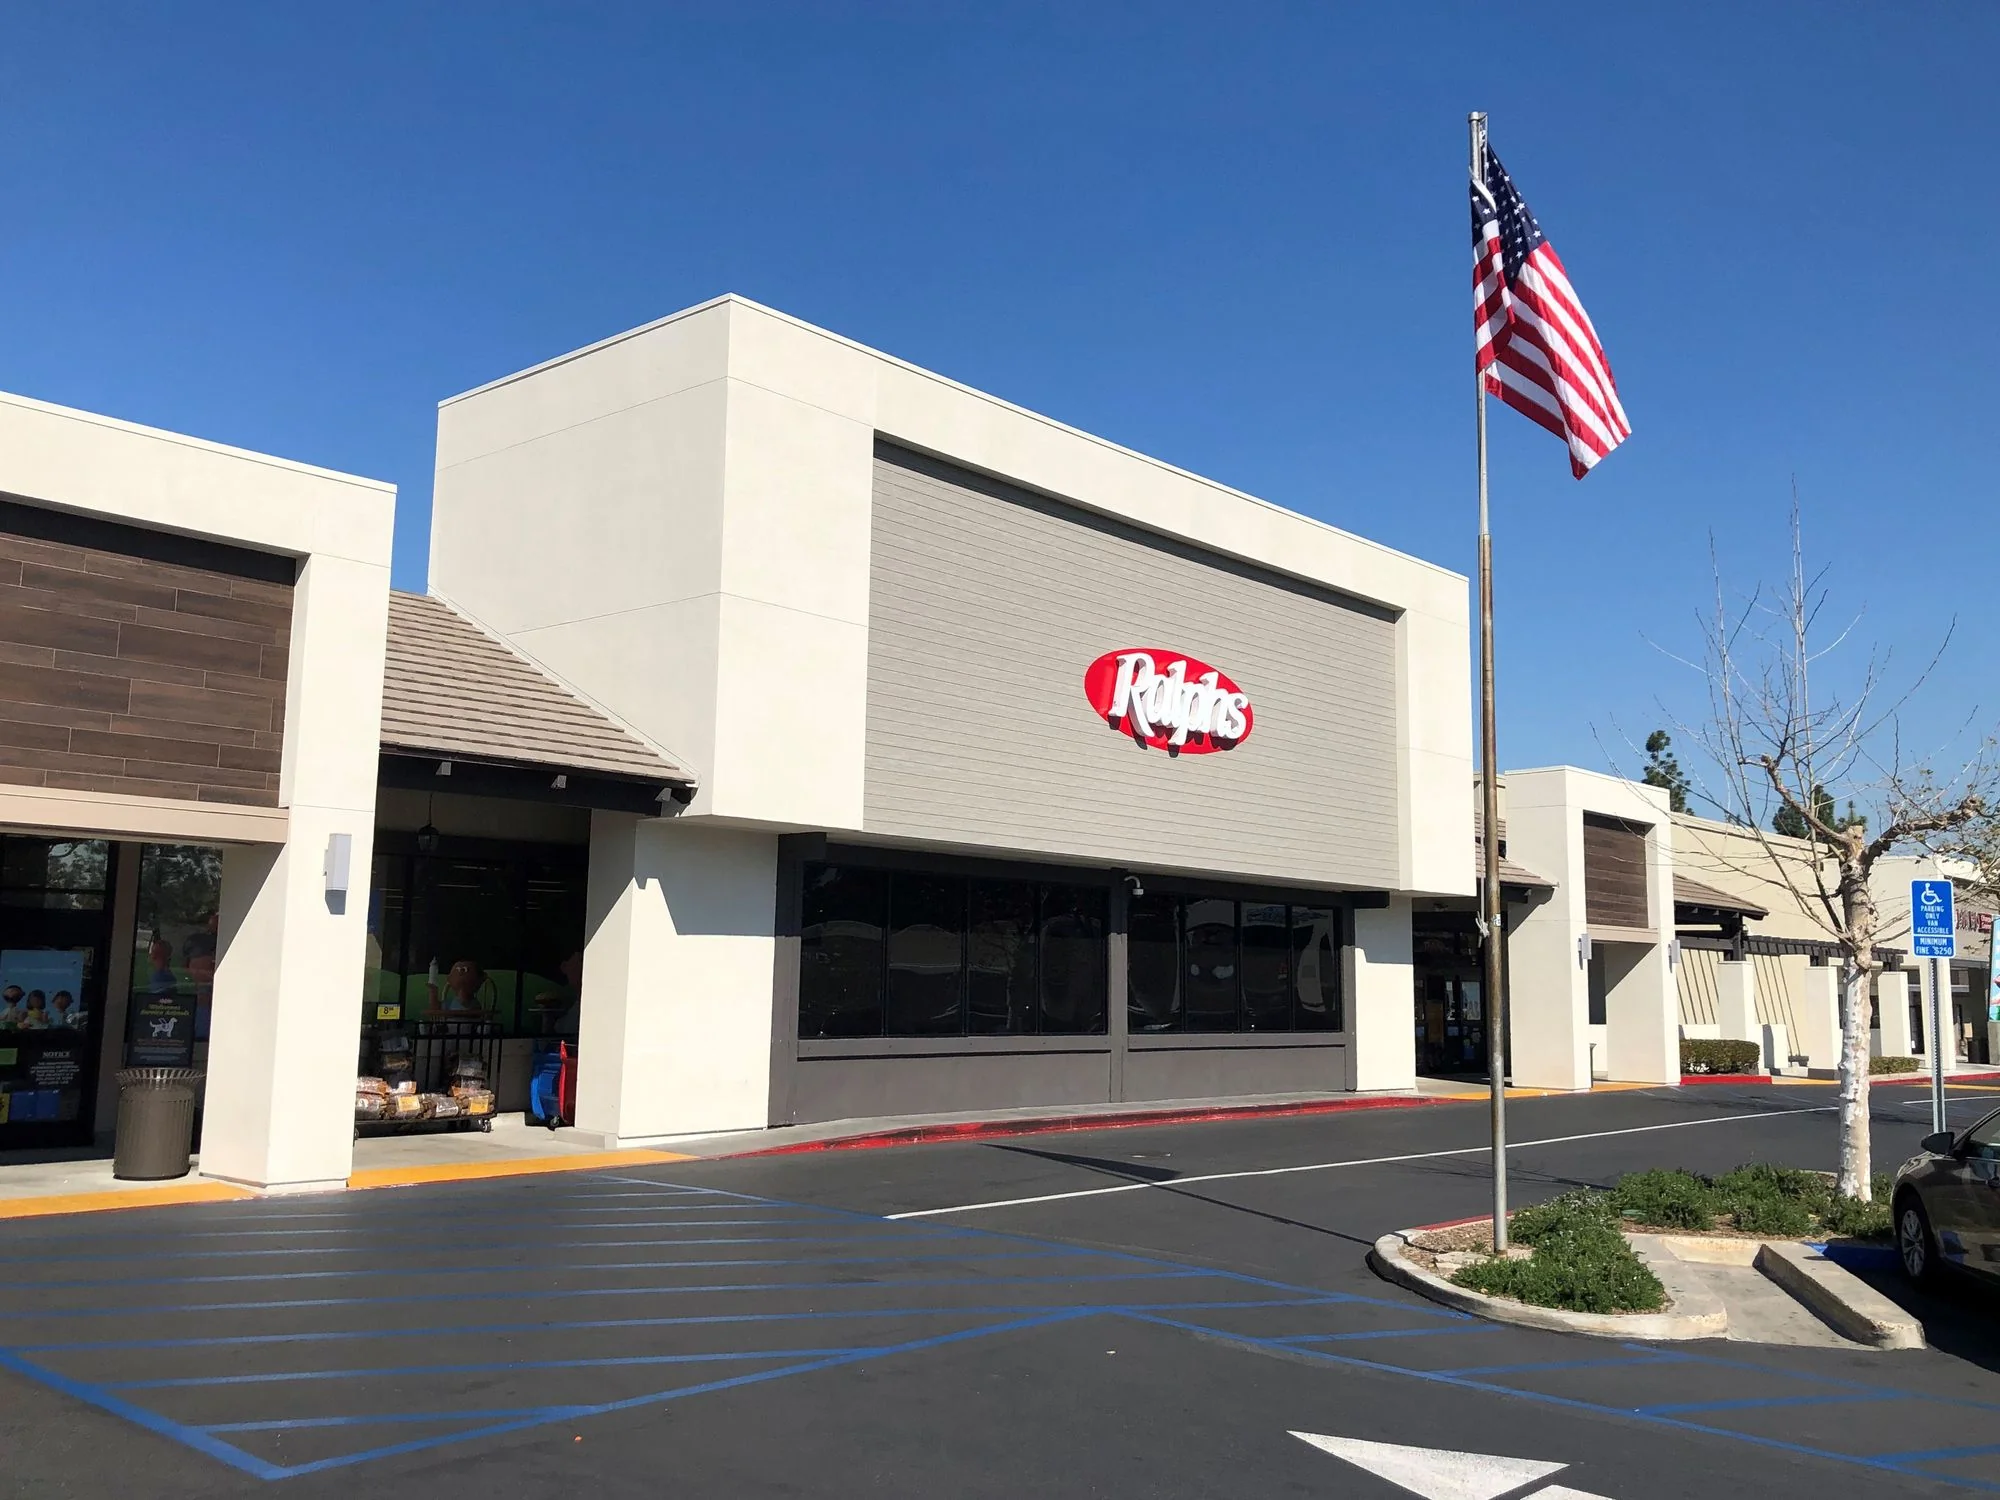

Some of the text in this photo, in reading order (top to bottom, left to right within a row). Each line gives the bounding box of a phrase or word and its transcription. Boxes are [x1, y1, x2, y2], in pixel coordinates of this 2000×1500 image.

[1109, 652, 1249, 746] Ralphs
[1925, 912, 1940, 920] ONLY
[1927, 919, 1938, 927] VAN
[1917, 926, 1949, 934] ACCESSIBLE
[1920, 937, 1948, 946] MINIMUM
[1916, 945, 1930, 955] FINE
